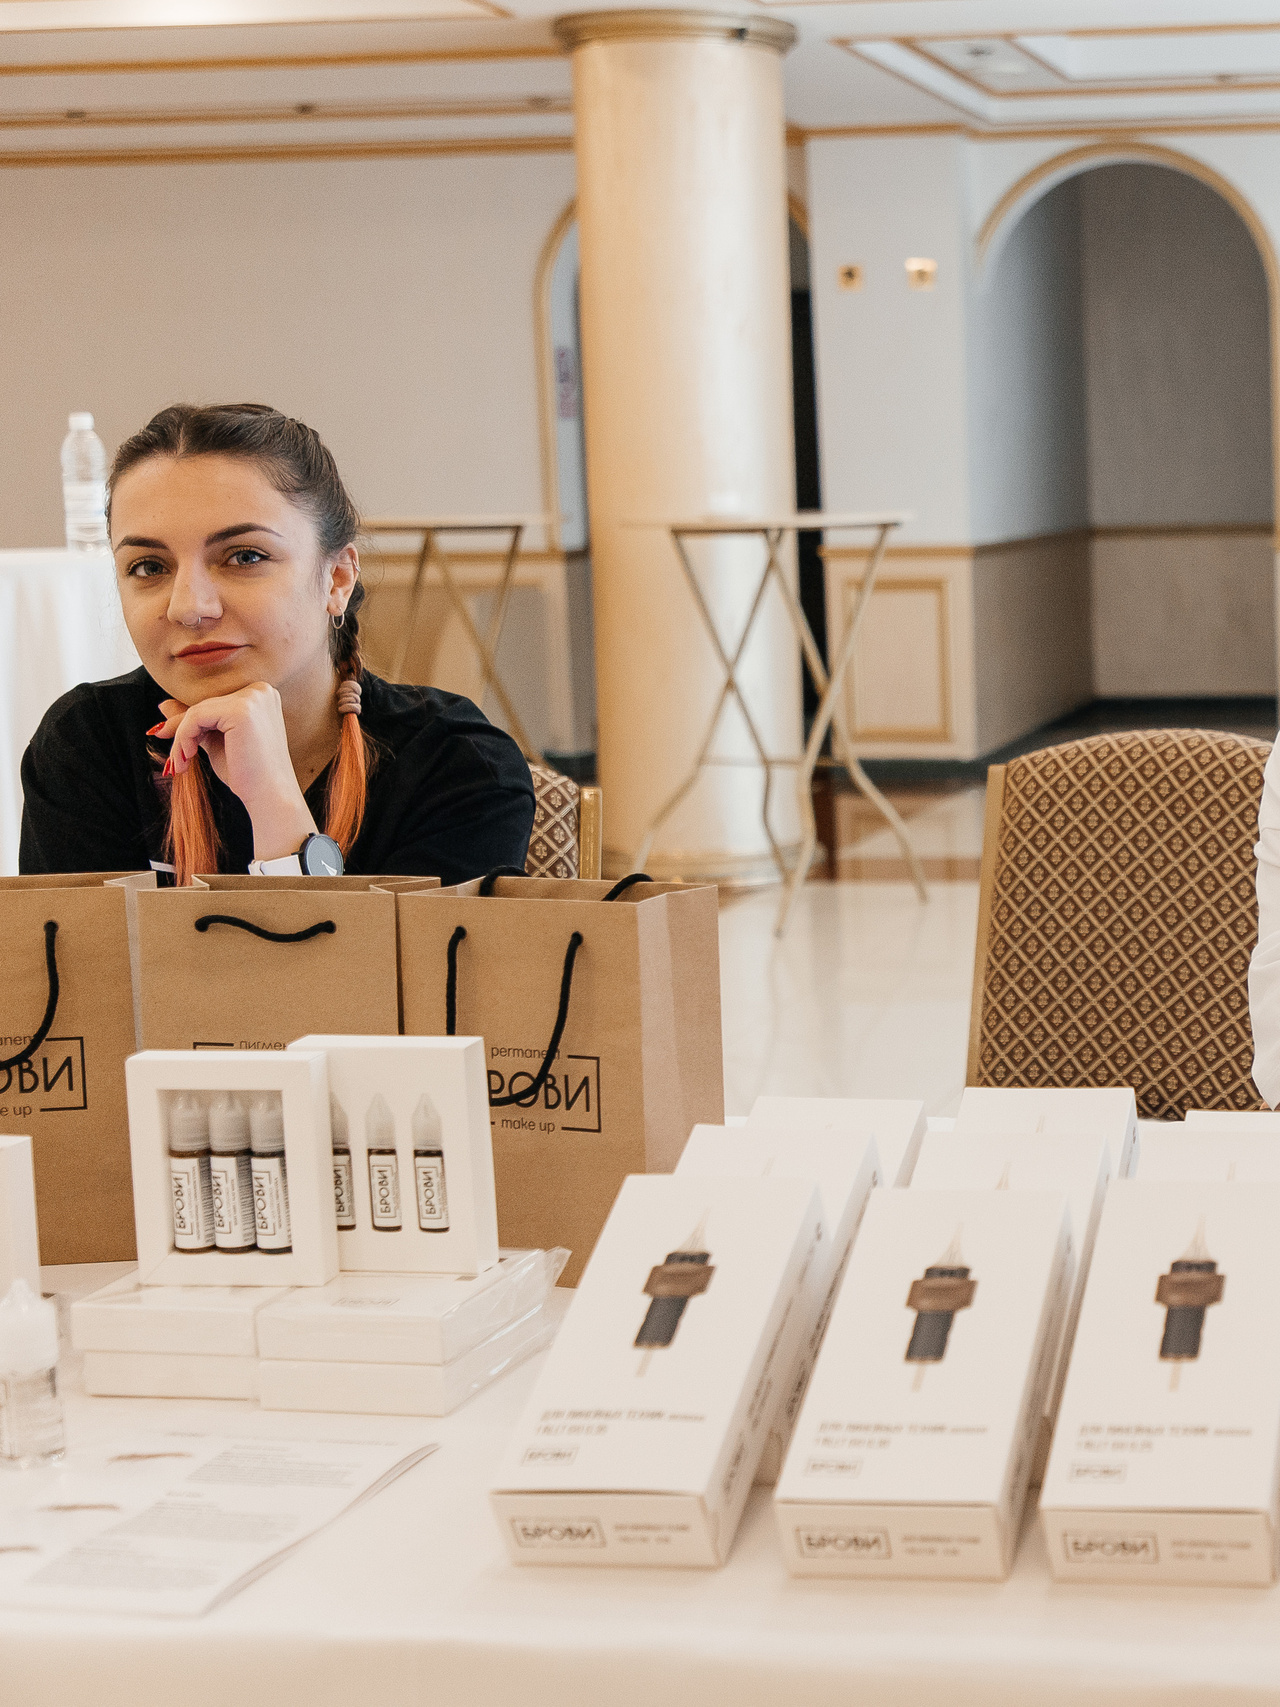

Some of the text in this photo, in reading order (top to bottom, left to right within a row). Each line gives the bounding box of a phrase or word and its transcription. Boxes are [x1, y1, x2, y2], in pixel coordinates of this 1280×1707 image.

[13, 1105, 32, 1118] up
[487, 1069, 590, 1112] РОВИ
[501, 1117, 556, 1135] make up
[173, 1176, 186, 1230] БРОВИ
[212, 1175, 225, 1228] БРОВИ
[254, 1175, 268, 1230] БРОВИ
[378, 1169, 391, 1214] БРОВИ
[422, 1170, 436, 1215] БРОВИ
